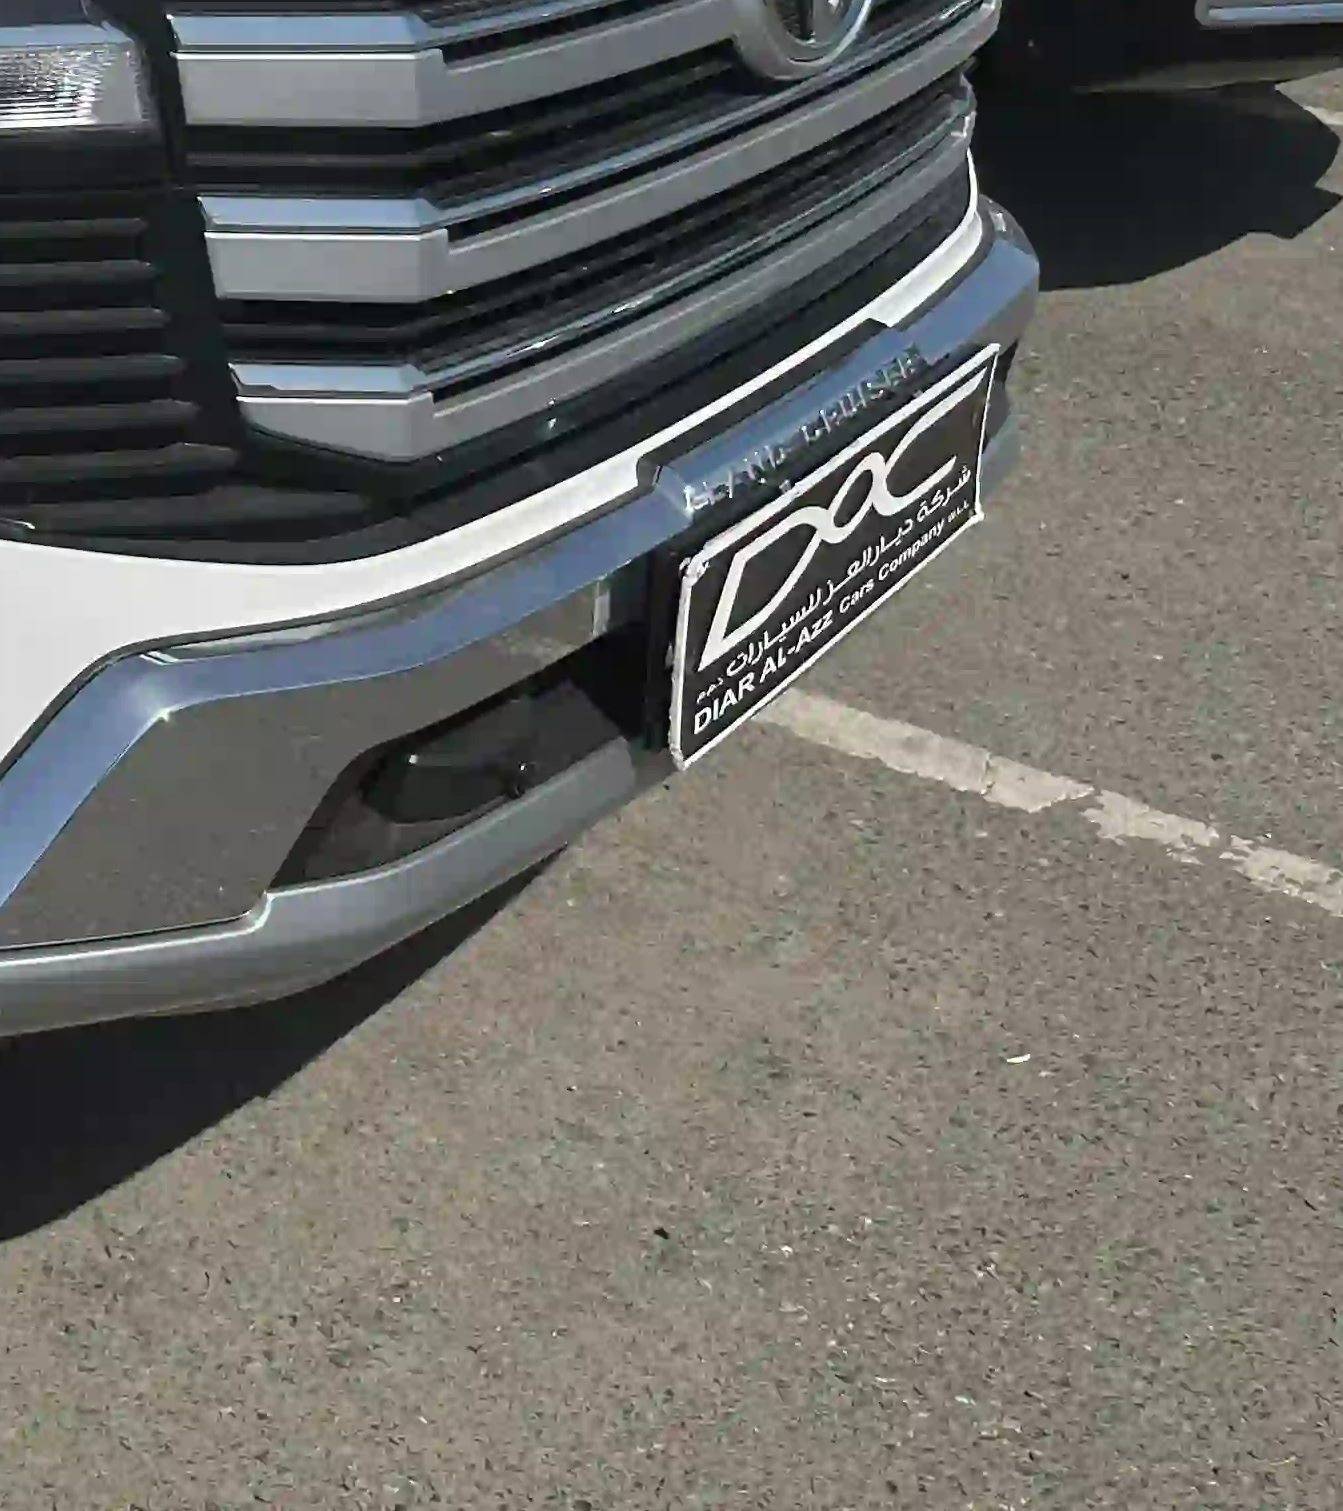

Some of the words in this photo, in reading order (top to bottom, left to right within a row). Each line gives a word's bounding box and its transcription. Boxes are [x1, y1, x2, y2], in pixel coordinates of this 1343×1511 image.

[916, 465, 972, 523] شركة
[693, 670, 756, 735] DIAR
[759, 609, 834, 685] AL-AZZ
[838, 579, 875, 615] Cars
[878, 516, 947, 583] Company
[726, 586, 825, 677] للسيارات
